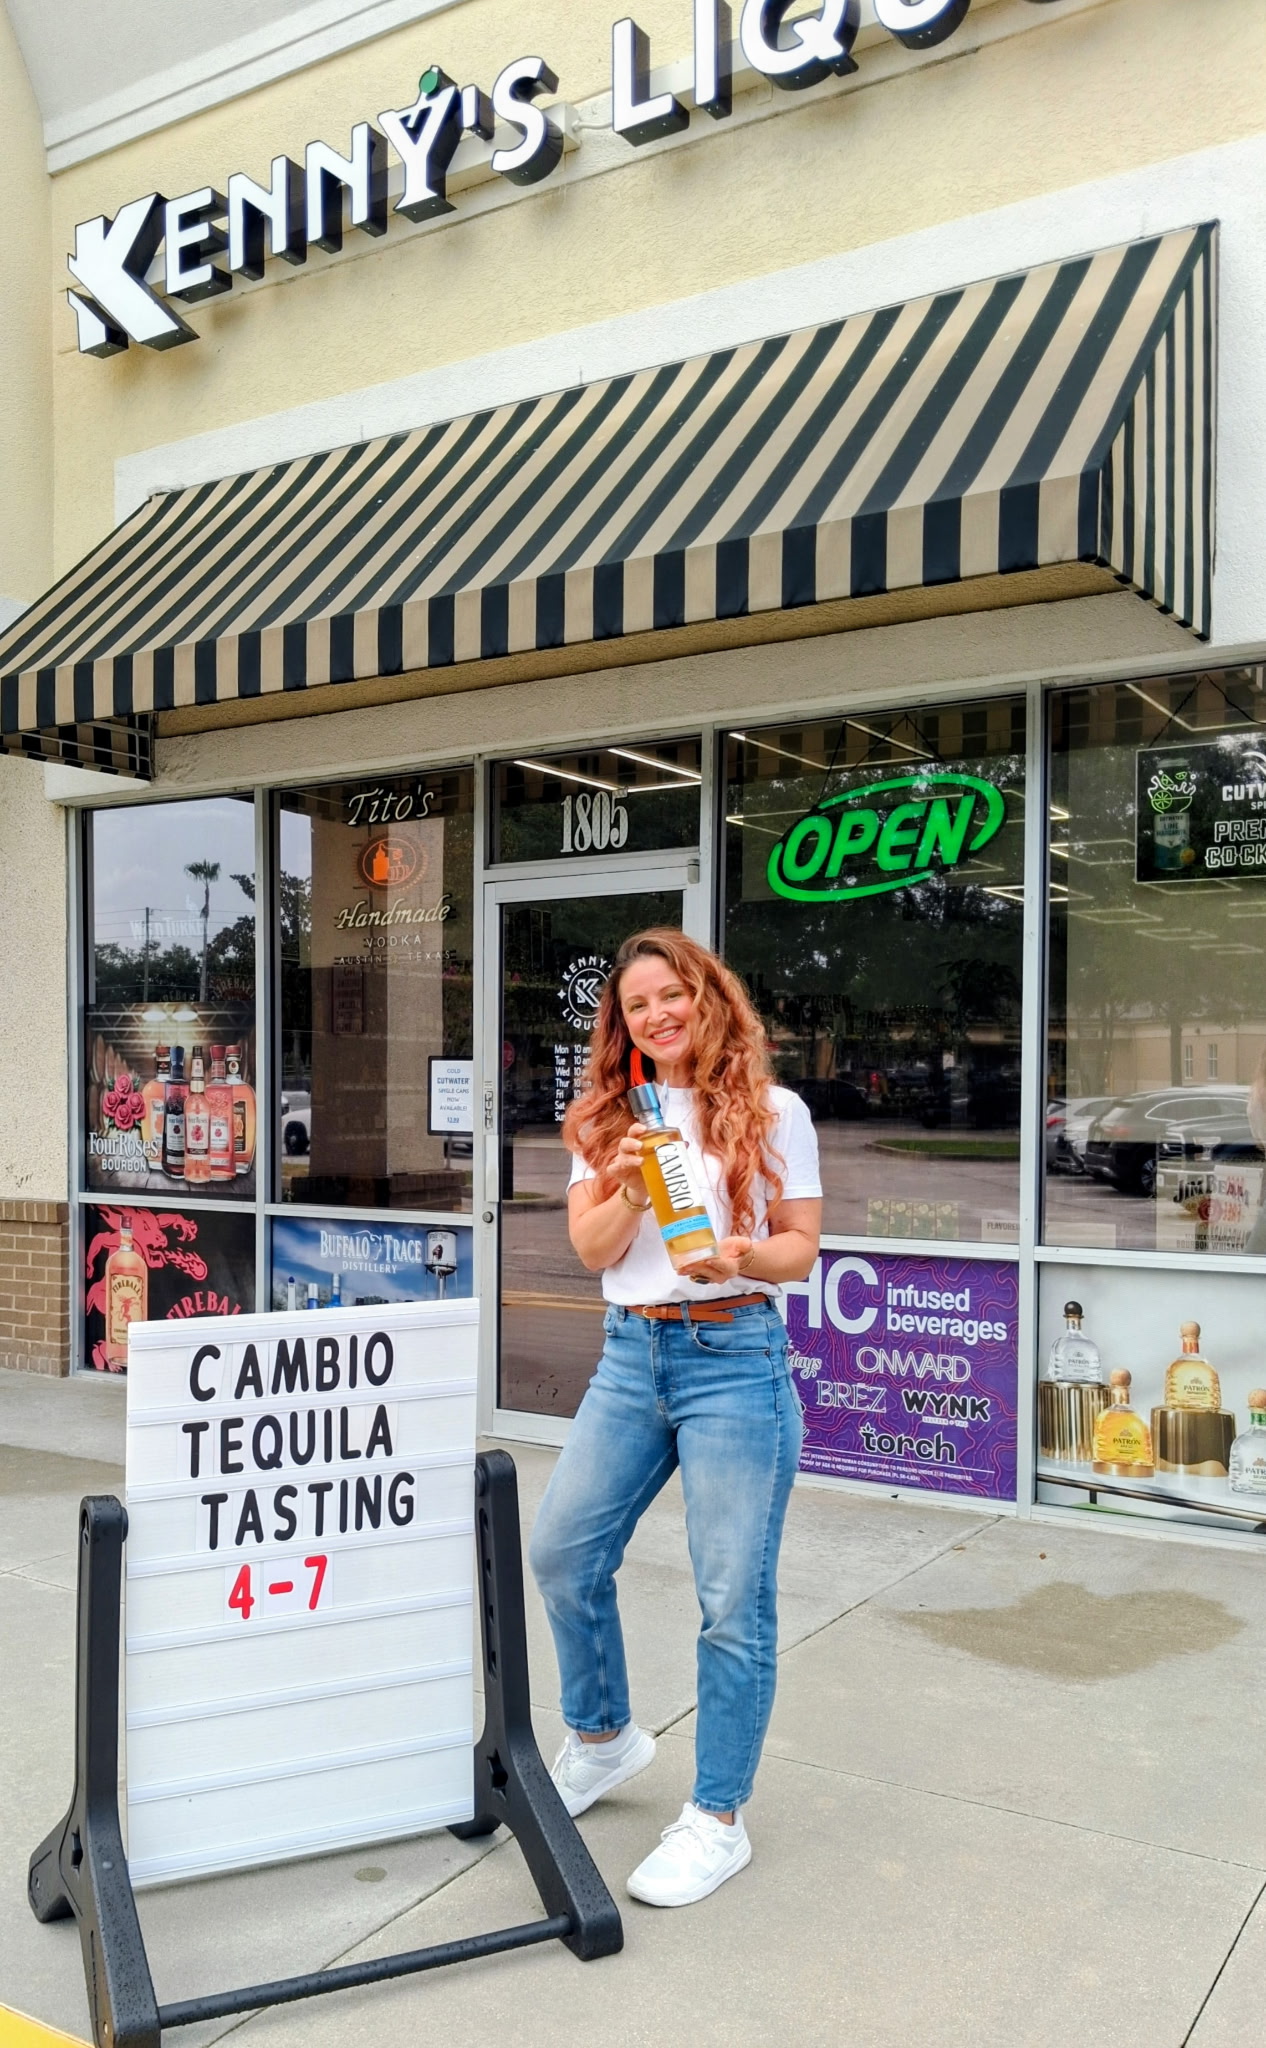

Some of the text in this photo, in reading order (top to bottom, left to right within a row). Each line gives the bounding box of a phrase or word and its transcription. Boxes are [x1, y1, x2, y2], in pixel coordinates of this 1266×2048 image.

[67, 56, 558, 358] KENNY'S
[347, 784, 434, 826] Tito's
[560, 787, 629, 853] 1805
[782, 794, 976, 882] OPEN
[336, 894, 452, 930] Handmade
[339, 950, 452, 965] AUSTIN TEXAS
[366, 935, 422, 948] VODKA
[562, 955, 614, 982] KENNY'
[554, 1044, 570, 1054] Mon
[573, 1044, 582, 1054] 10
[554, 1055, 566, 1065] Tue
[573, 1055, 582, 1065] 10
[436, 1077, 470, 1085] CUTWATER
[554, 1066, 571, 1077] Wed
[573, 1066, 582, 1076] 10
[555, 1078, 570, 1088] Thur
[573, 1078, 582, 1088] 10
[554, 1100, 566, 1111] Sat
[555, 1089, 565, 1099] Fri
[573, 1089, 582, 1099] 10
[101, 1158, 147, 1172] BOURBON
[655, 1142, 696, 1212] CAMBIO
[1173, 1179, 1204, 1203] JIM
[320, 1230, 423, 1264] BUFFALO TRACE
[1176, 1239, 1209, 1251] BOURBON
[342, 1260, 398, 1274] DISTILLERY
[112, 1279, 142, 1295] FIREBALL
[777, 1256, 879, 1335] HC
[887, 1282, 970, 1312] infused
[886, 1307, 1008, 1346] beverages
[189, 1331, 394, 1402] CAMBIO
[856, 1346, 972, 1383] ONWARD
[902, 1388, 991, 1423] WYNK
[182, 1404, 393, 1478] TEQUILA
[860, 1430, 957, 1464] torch
[201, 1472, 415, 1551] TASTING
[228, 1554, 329, 1620] 4-7
